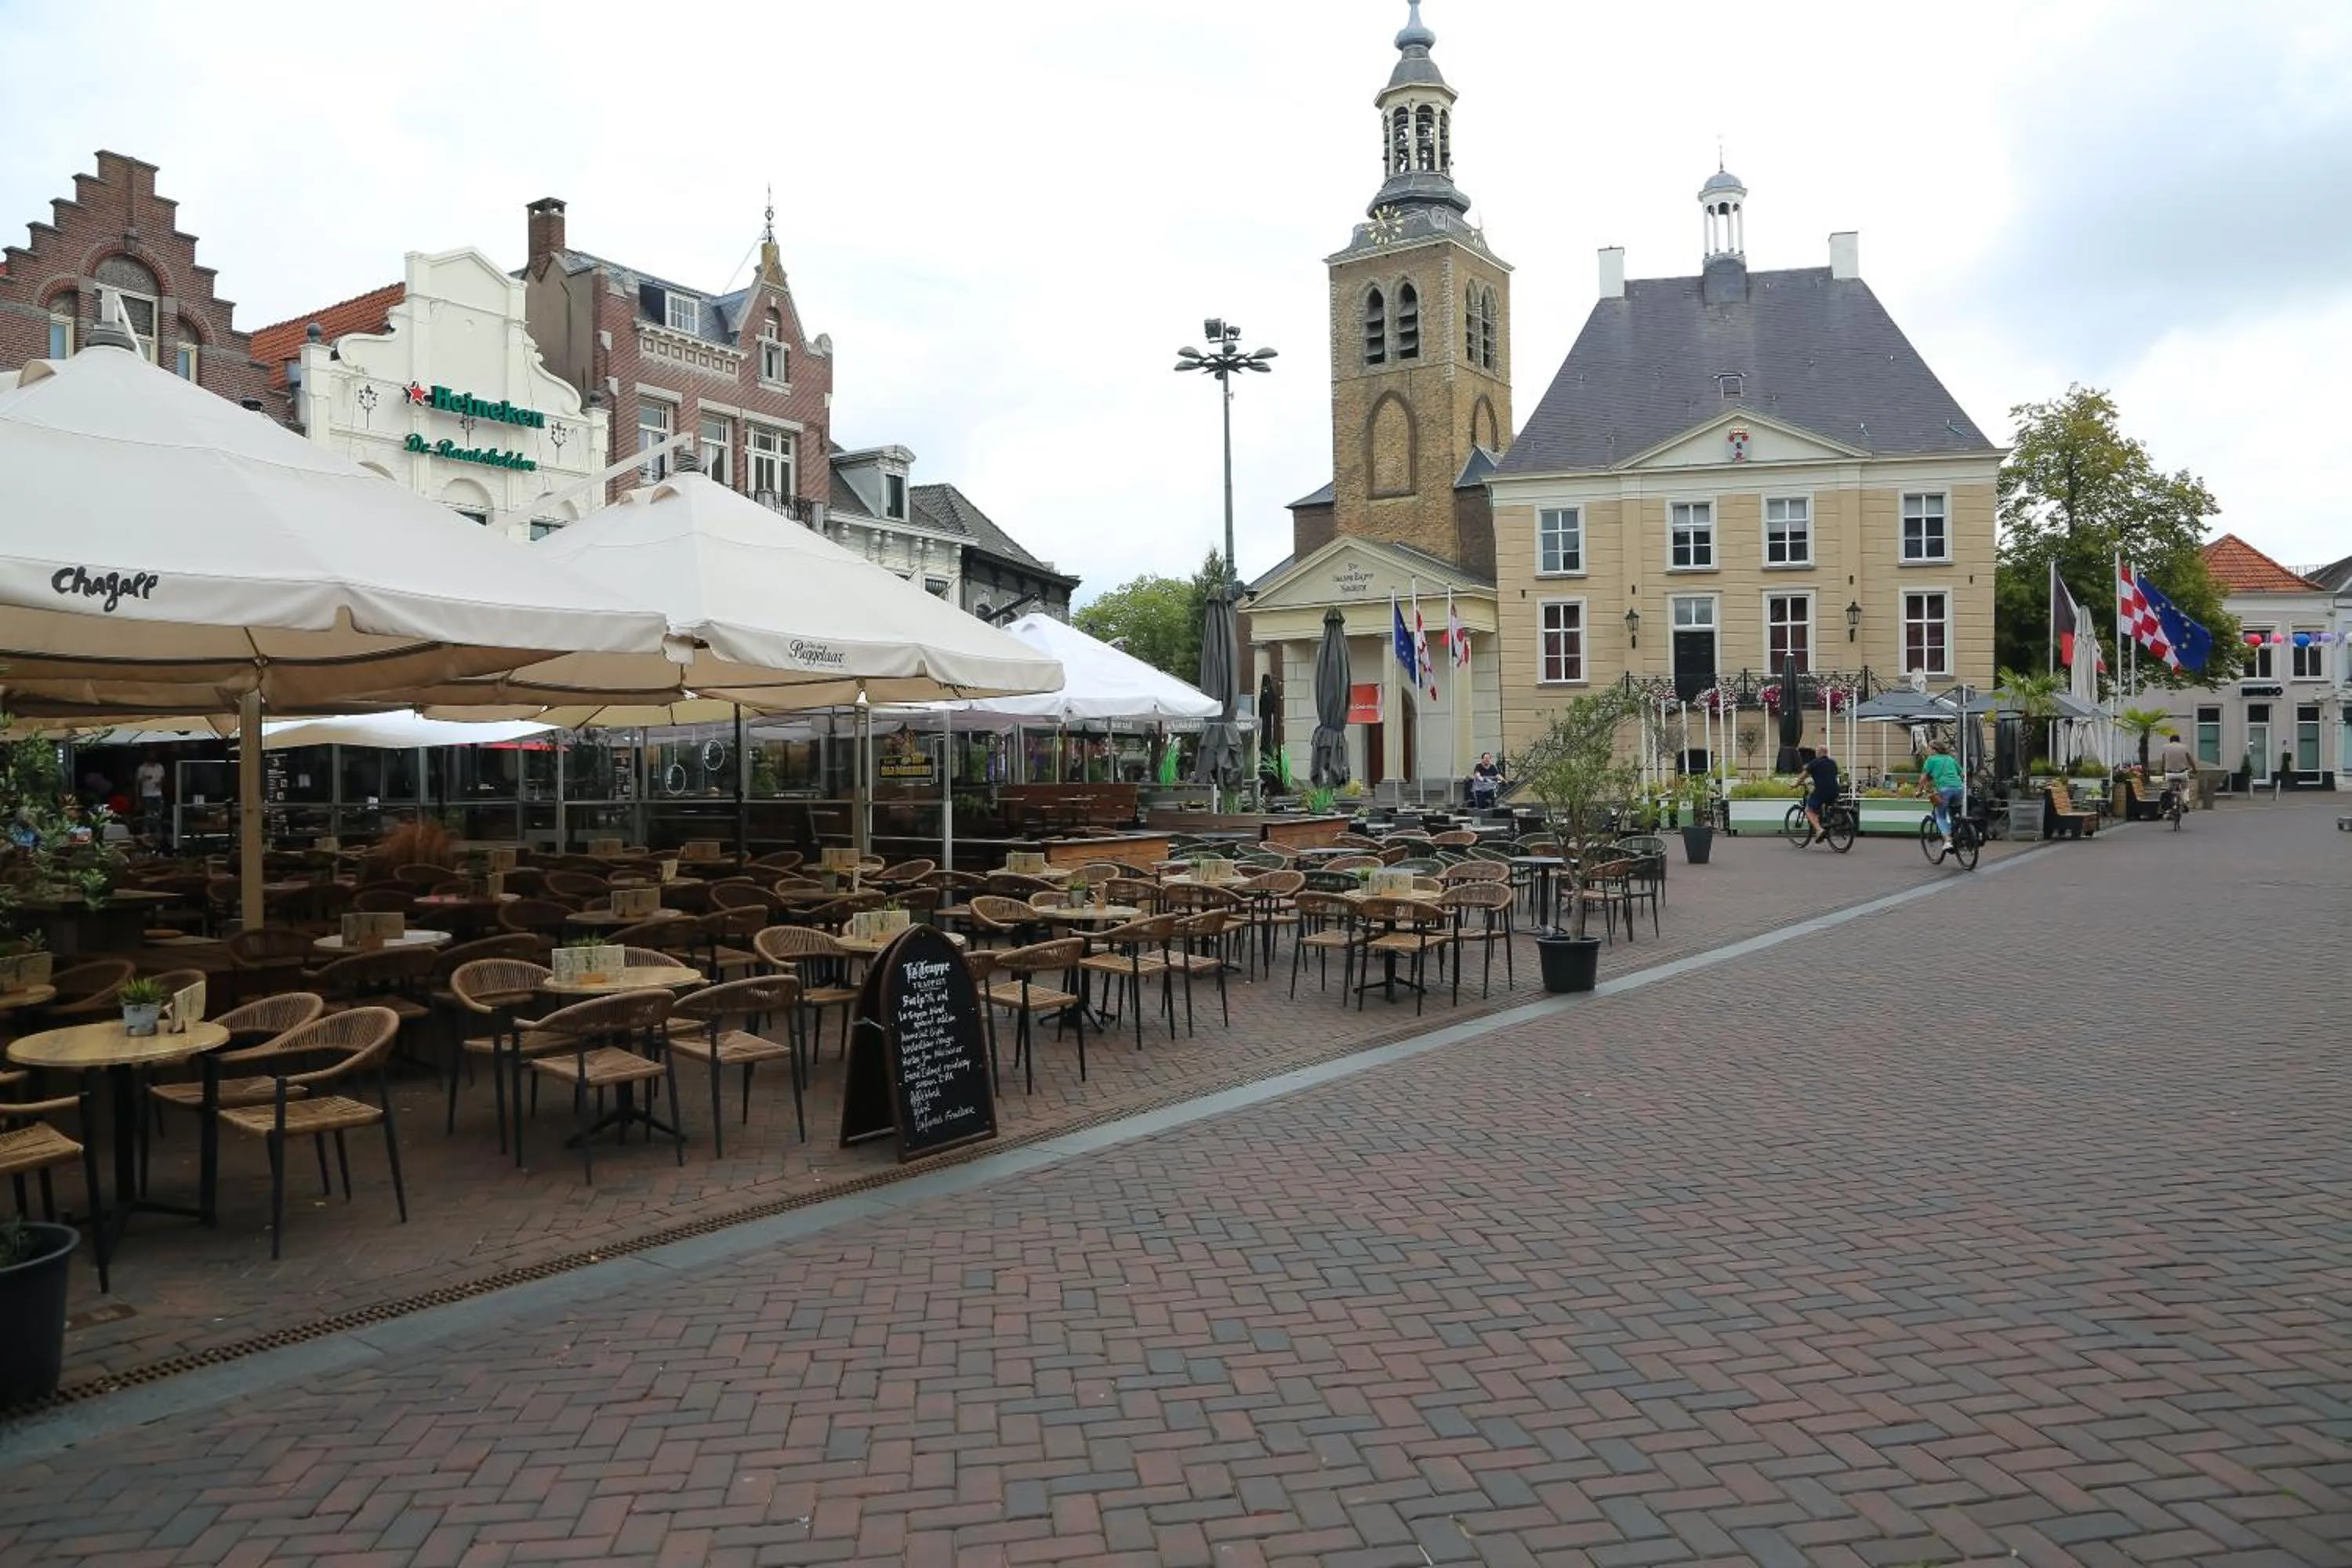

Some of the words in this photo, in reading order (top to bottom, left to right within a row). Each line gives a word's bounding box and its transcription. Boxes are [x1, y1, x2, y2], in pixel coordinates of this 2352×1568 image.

[431, 384, 546, 429] Heineken
[404, 433, 430, 453] De
[51, 565, 159, 612] Chagall
